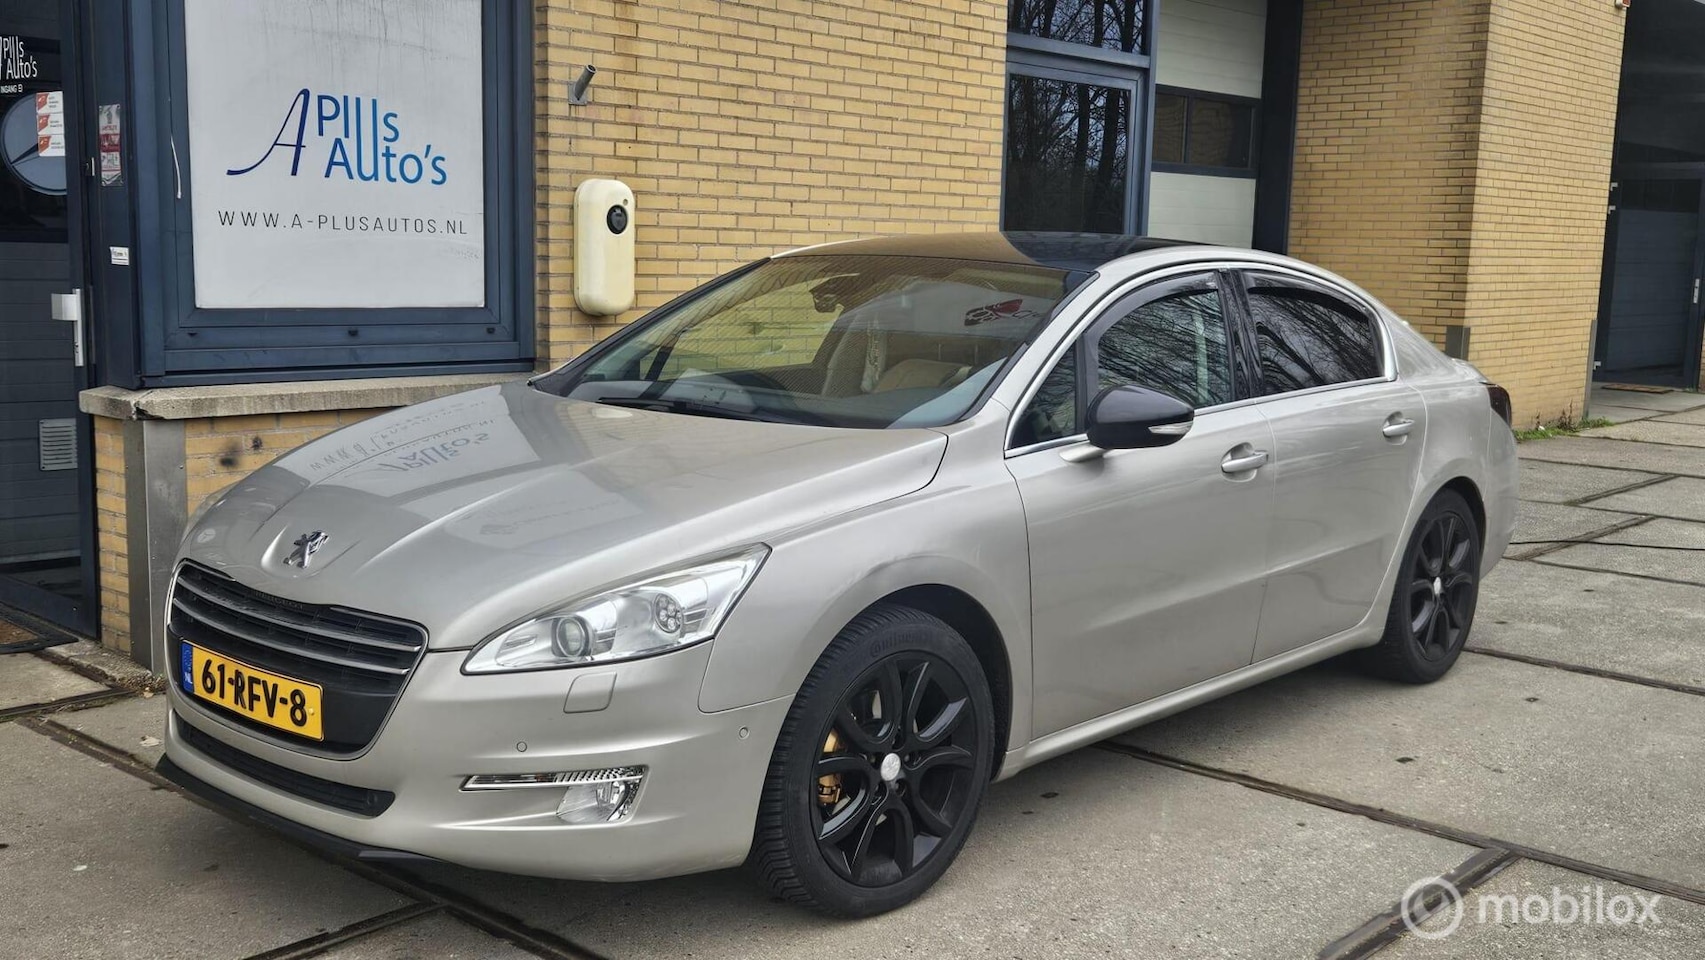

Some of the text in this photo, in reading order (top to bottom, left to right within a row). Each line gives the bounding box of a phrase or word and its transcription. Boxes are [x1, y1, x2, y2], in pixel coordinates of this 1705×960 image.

[226, 88, 310, 176] A
[324, 130, 447, 185] Auto's
[218, 210, 468, 235] WWW.A-PLUSAUTOS.NL
[201, 658, 308, 728] 61-RFV-8
